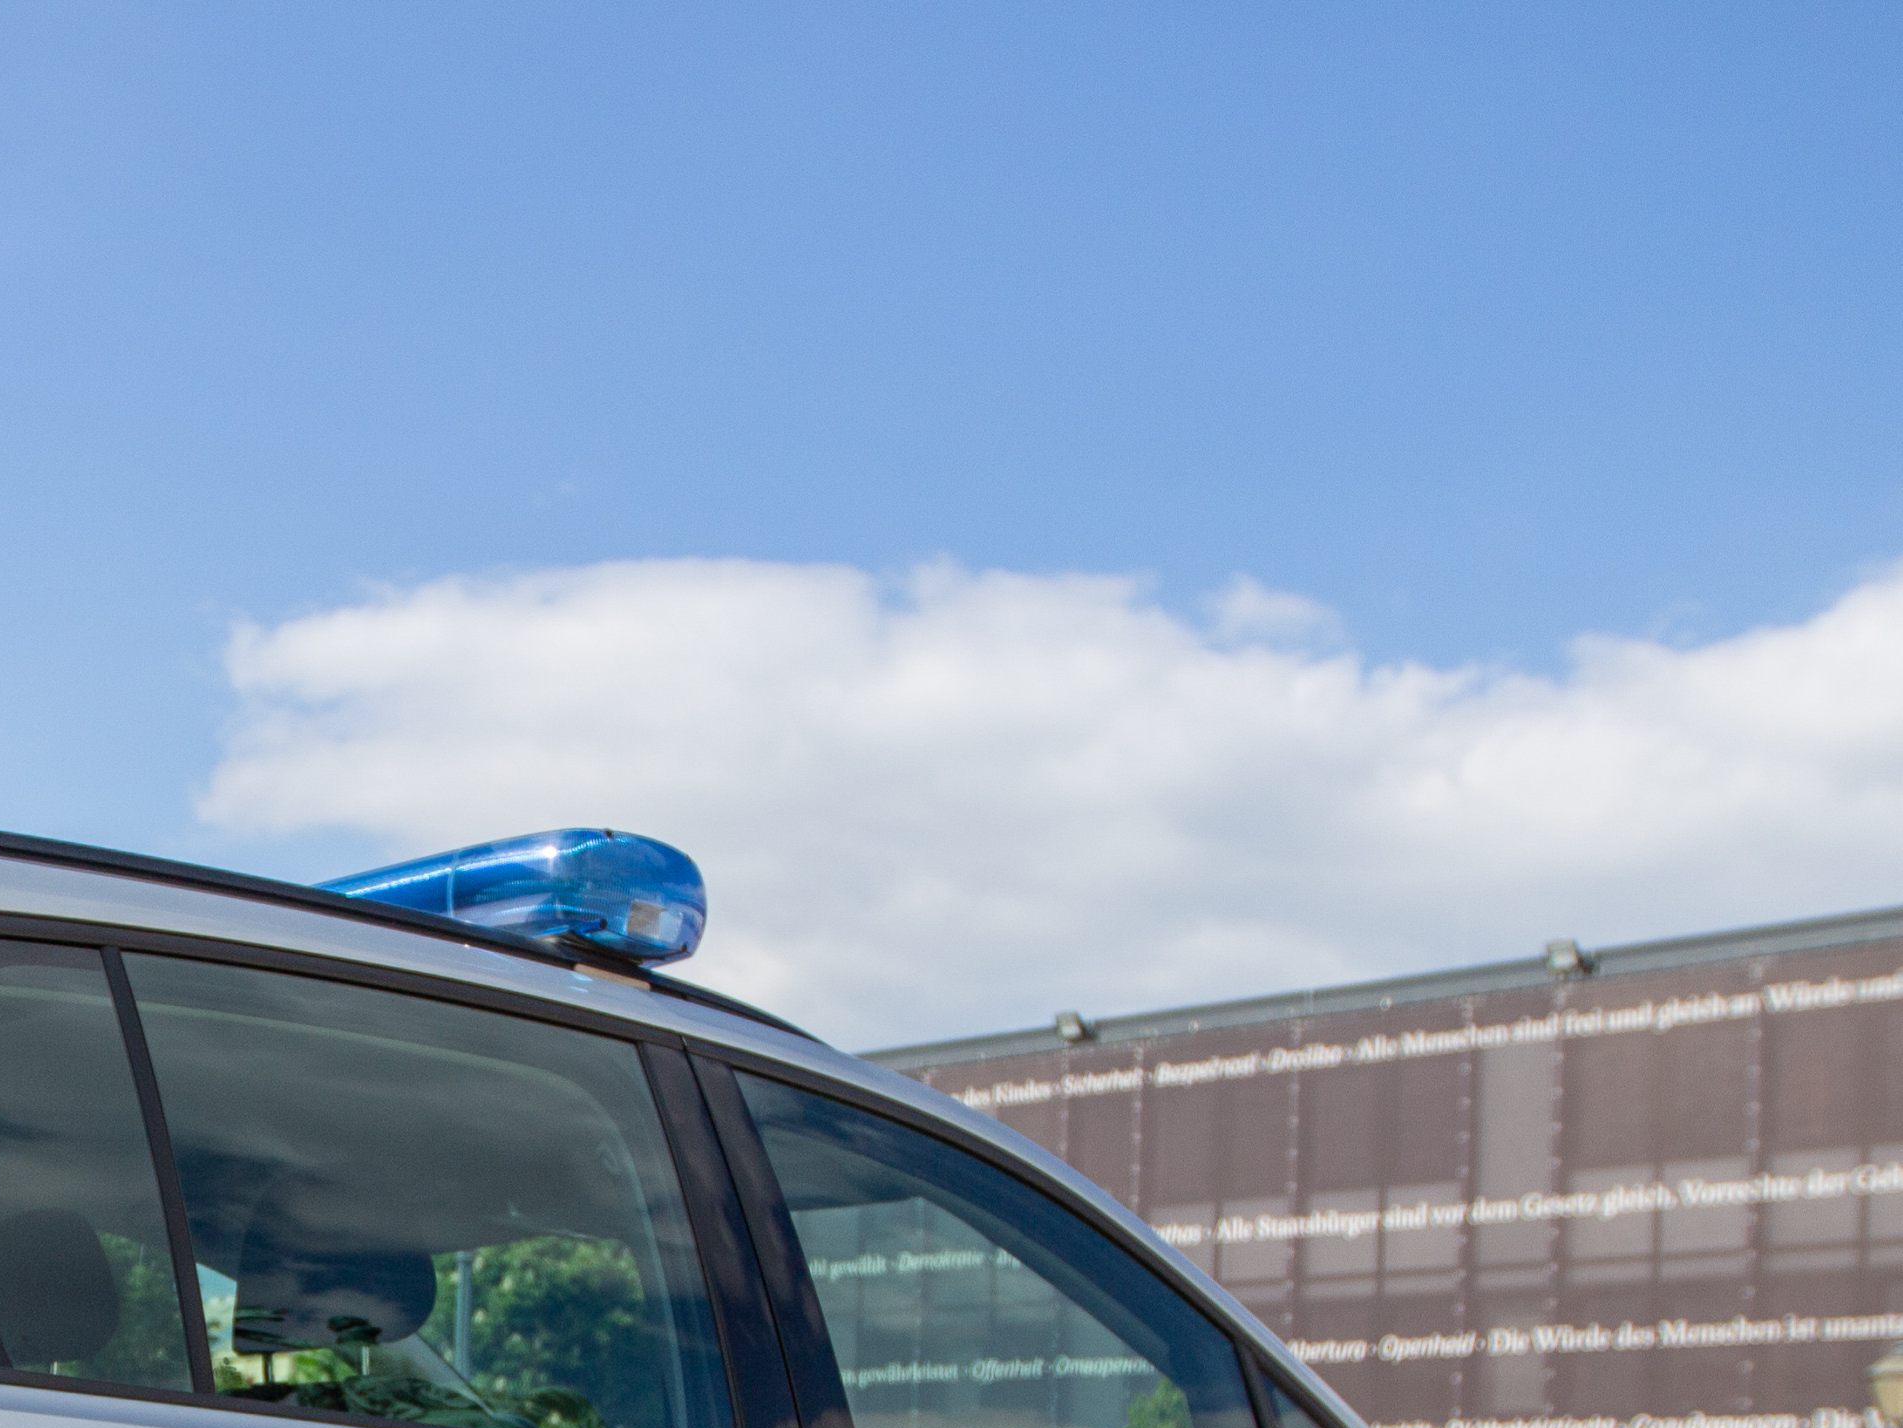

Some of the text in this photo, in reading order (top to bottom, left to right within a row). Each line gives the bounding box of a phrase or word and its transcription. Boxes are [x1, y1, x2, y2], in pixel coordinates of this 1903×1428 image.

[994, 1078, 1052, 1105] Kindes
[1062, 1067, 1143, 1096] Sicherheit
[1356, 1034, 1398, 1063] Alle
[1400, 1022, 1508, 1056] Menschen
[1510, 1012, 1560, 1047] sind
[1562, 1007, 1603, 1036] frei
[1604, 1001, 1652, 1034] und
[1652, 991, 1727, 1034] gleich
[1727, 993, 1762, 1018] an
[1762, 976, 1855, 1013] Würde
[896, 1249, 986, 1273] Demokratie
[1217, 1215, 1254, 1244] Alle
[1255, 1209, 1381, 1240] Staatsbürger
[1383, 1202, 1429, 1231] sind
[1430, 1204, 1468, 1226] vor
[1469, 1196, 1518, 1225] dem
[1519, 1191, 1598, 1221] Gesetz
[1678, 1172, 1800, 1206] Vorrechte
[1801, 1167, 1848, 1198] der
[970, 1358, 1044, 1385] Offenheit
[1378, 1329, 1478, 1364] Openheid
[1486, 1327, 1530, 1356] Die
[1531, 1322, 1612, 1353] Würde
[1613, 1320, 1656, 1350] des
[1657, 1314, 1781, 1348] Menschen
[1782, 1313, 1818, 1342] ist
